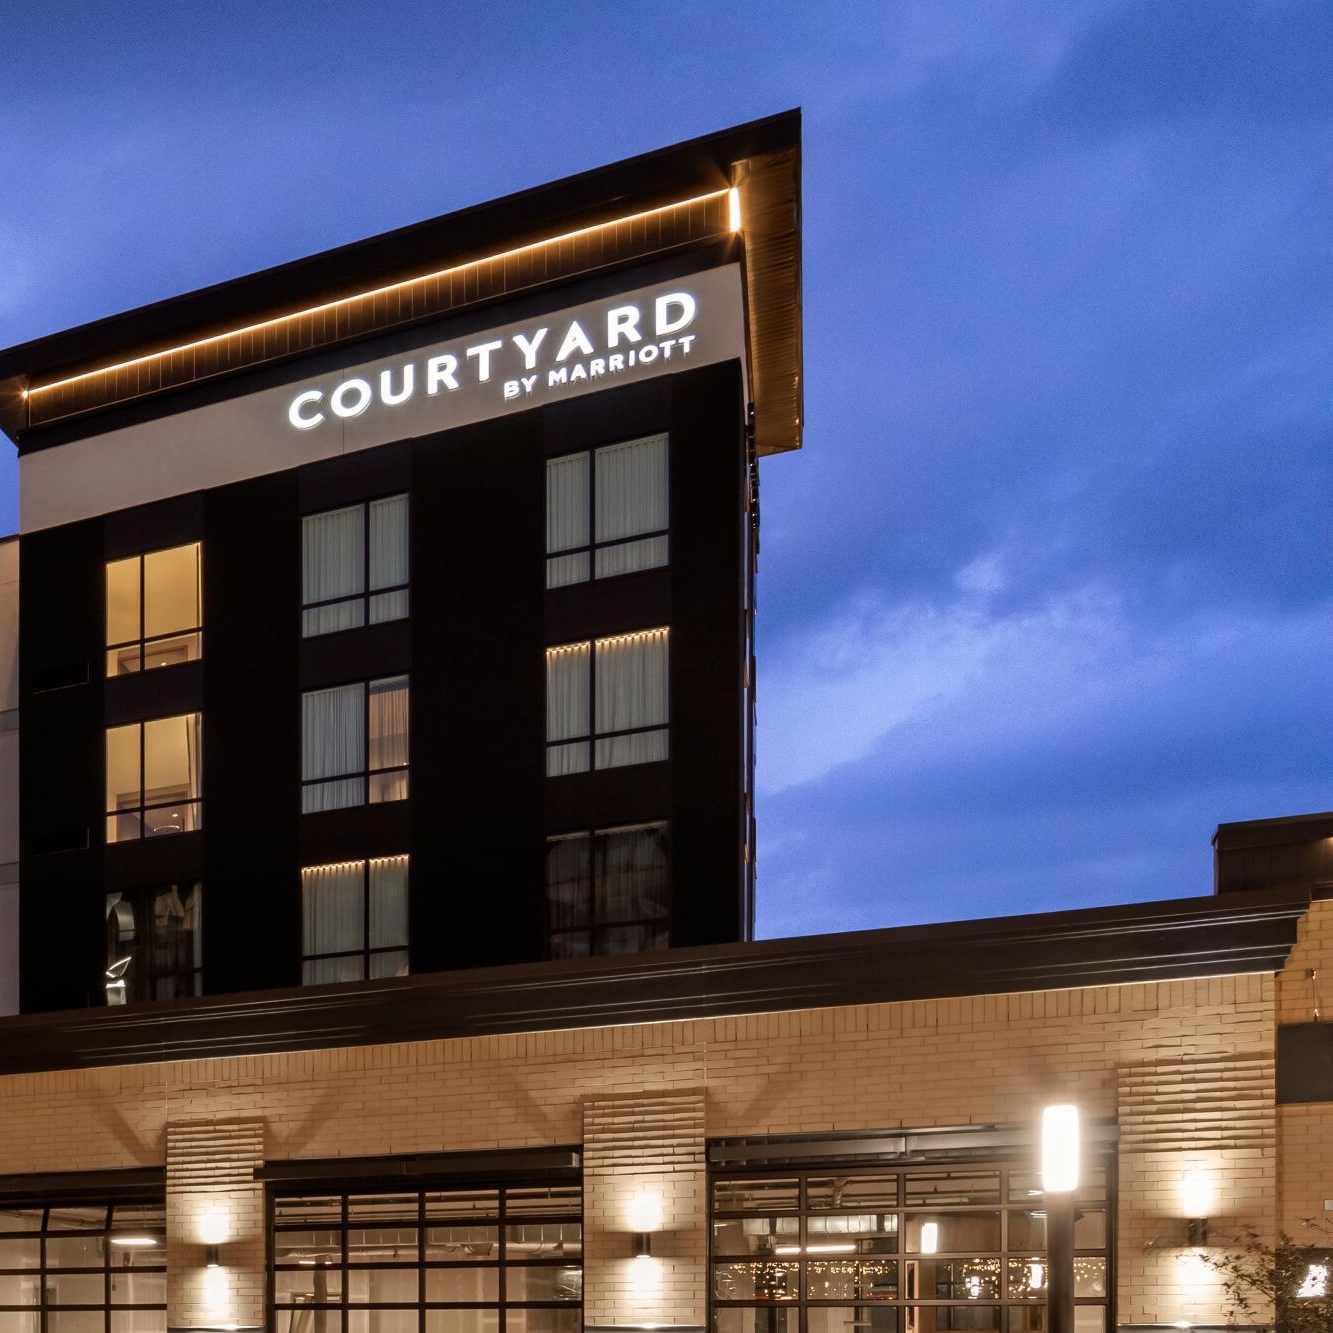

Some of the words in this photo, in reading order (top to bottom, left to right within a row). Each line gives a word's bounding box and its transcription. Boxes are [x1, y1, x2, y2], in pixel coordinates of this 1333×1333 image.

[288, 291, 697, 430] COURTYARD
[503, 375, 538, 400] BY
[548, 334, 696, 385] MARRIOTT
